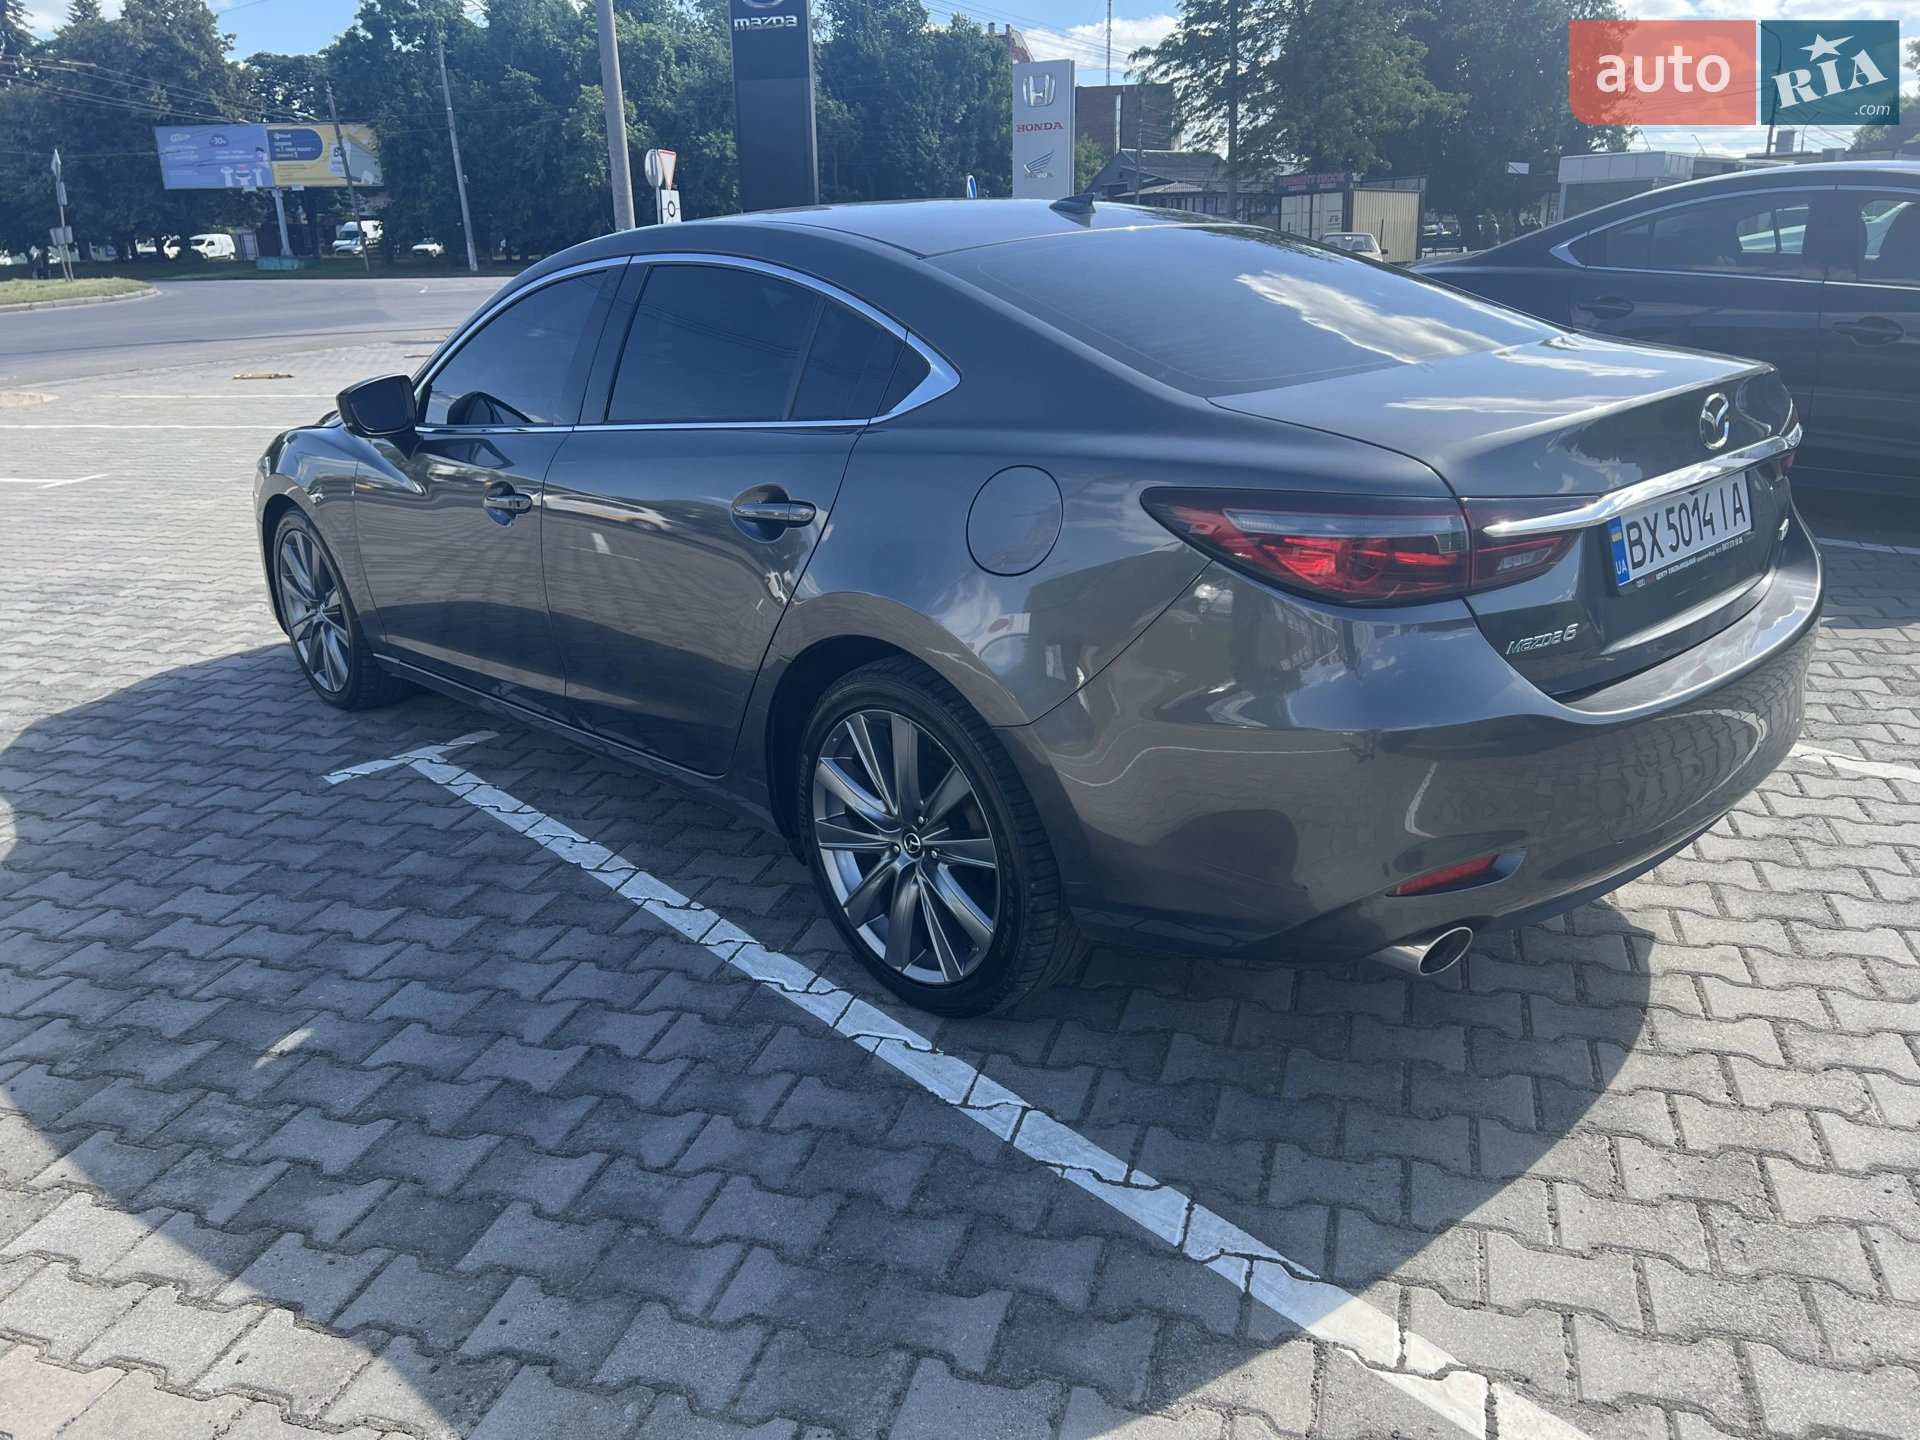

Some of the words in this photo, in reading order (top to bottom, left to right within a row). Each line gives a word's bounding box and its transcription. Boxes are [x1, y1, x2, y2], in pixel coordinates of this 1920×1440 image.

[1016, 121, 1064, 133] HONDA
[1625, 512, 1665, 571] BX
[1665, 492, 1716, 552] 5014
[1719, 481, 1746, 531] IA
[1615, 560, 1628, 575] UA
[798, 753, 811, 838] SUMITOMO
